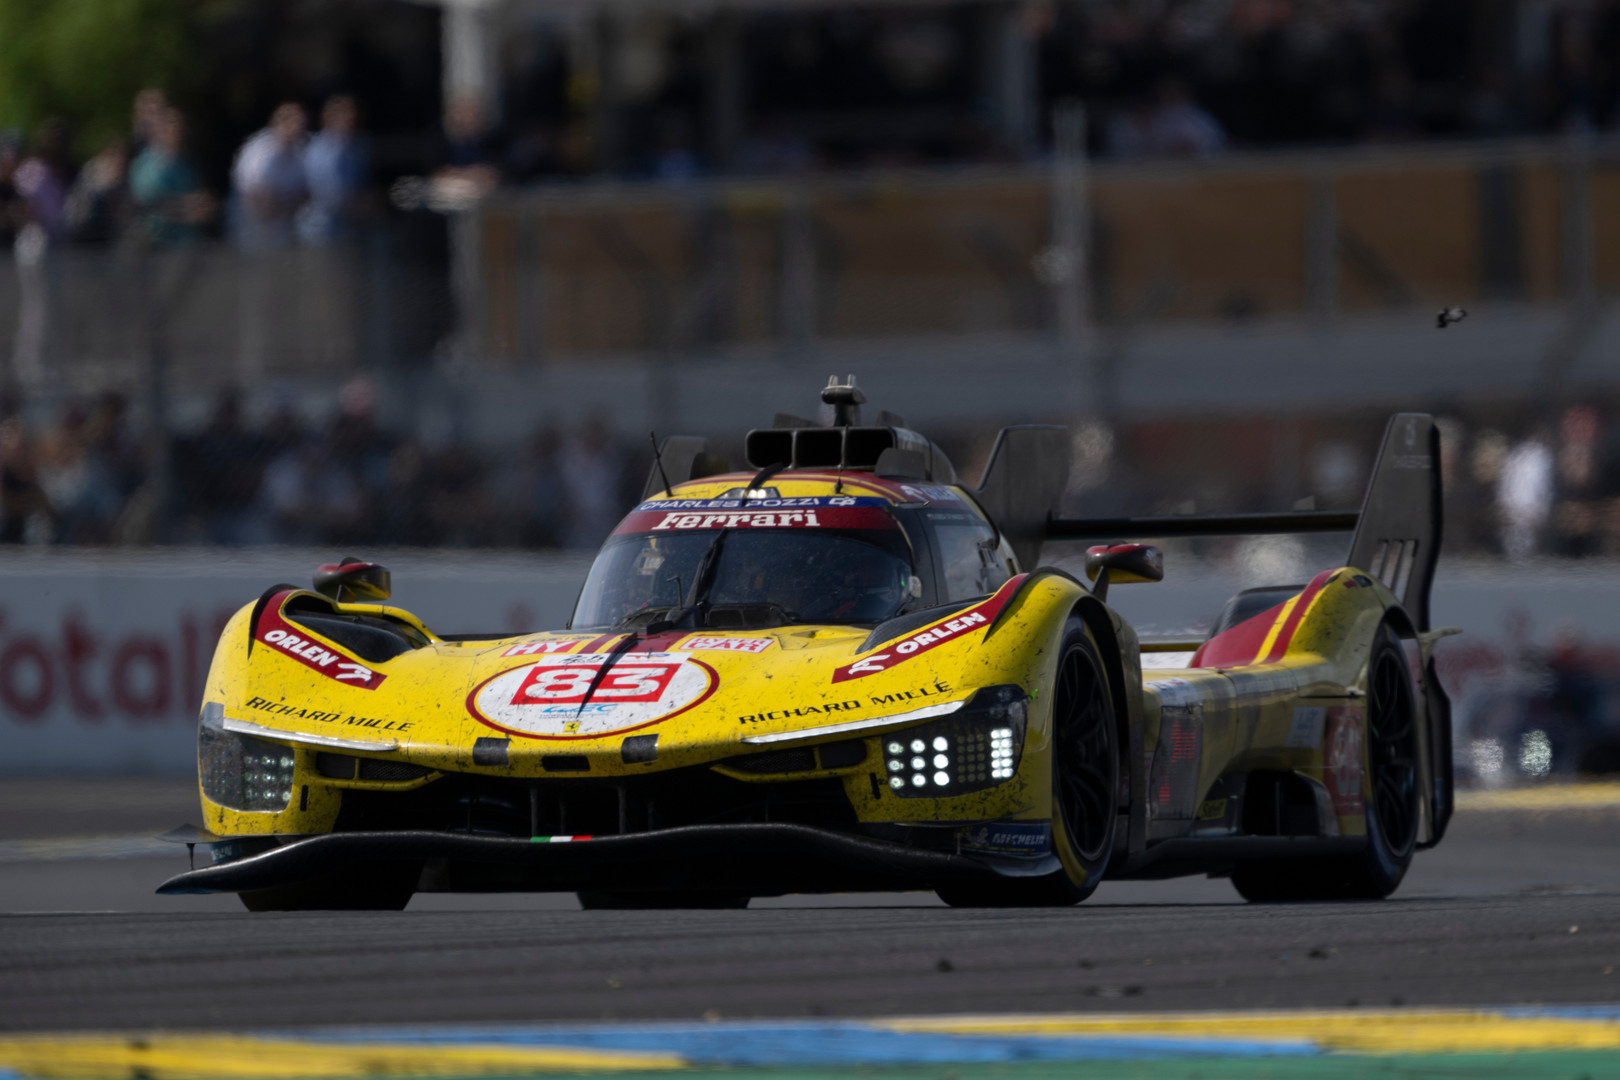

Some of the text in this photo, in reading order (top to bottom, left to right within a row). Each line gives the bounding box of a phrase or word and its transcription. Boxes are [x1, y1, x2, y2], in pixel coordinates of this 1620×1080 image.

[640, 498, 820, 512] CHARLES POZZI
[651, 510, 821, 530] Ferrari
[263, 629, 339, 668] ORLEN
[688, 642, 760, 651] CAR
[895, 611, 986, 655] ORLEN
[524, 667, 661, 700] 83
[246, 696, 415, 732] RICHARD MILLE
[739, 681, 953, 724] RICHARD MILLE
[992, 832, 1046, 846] MICHELIN
